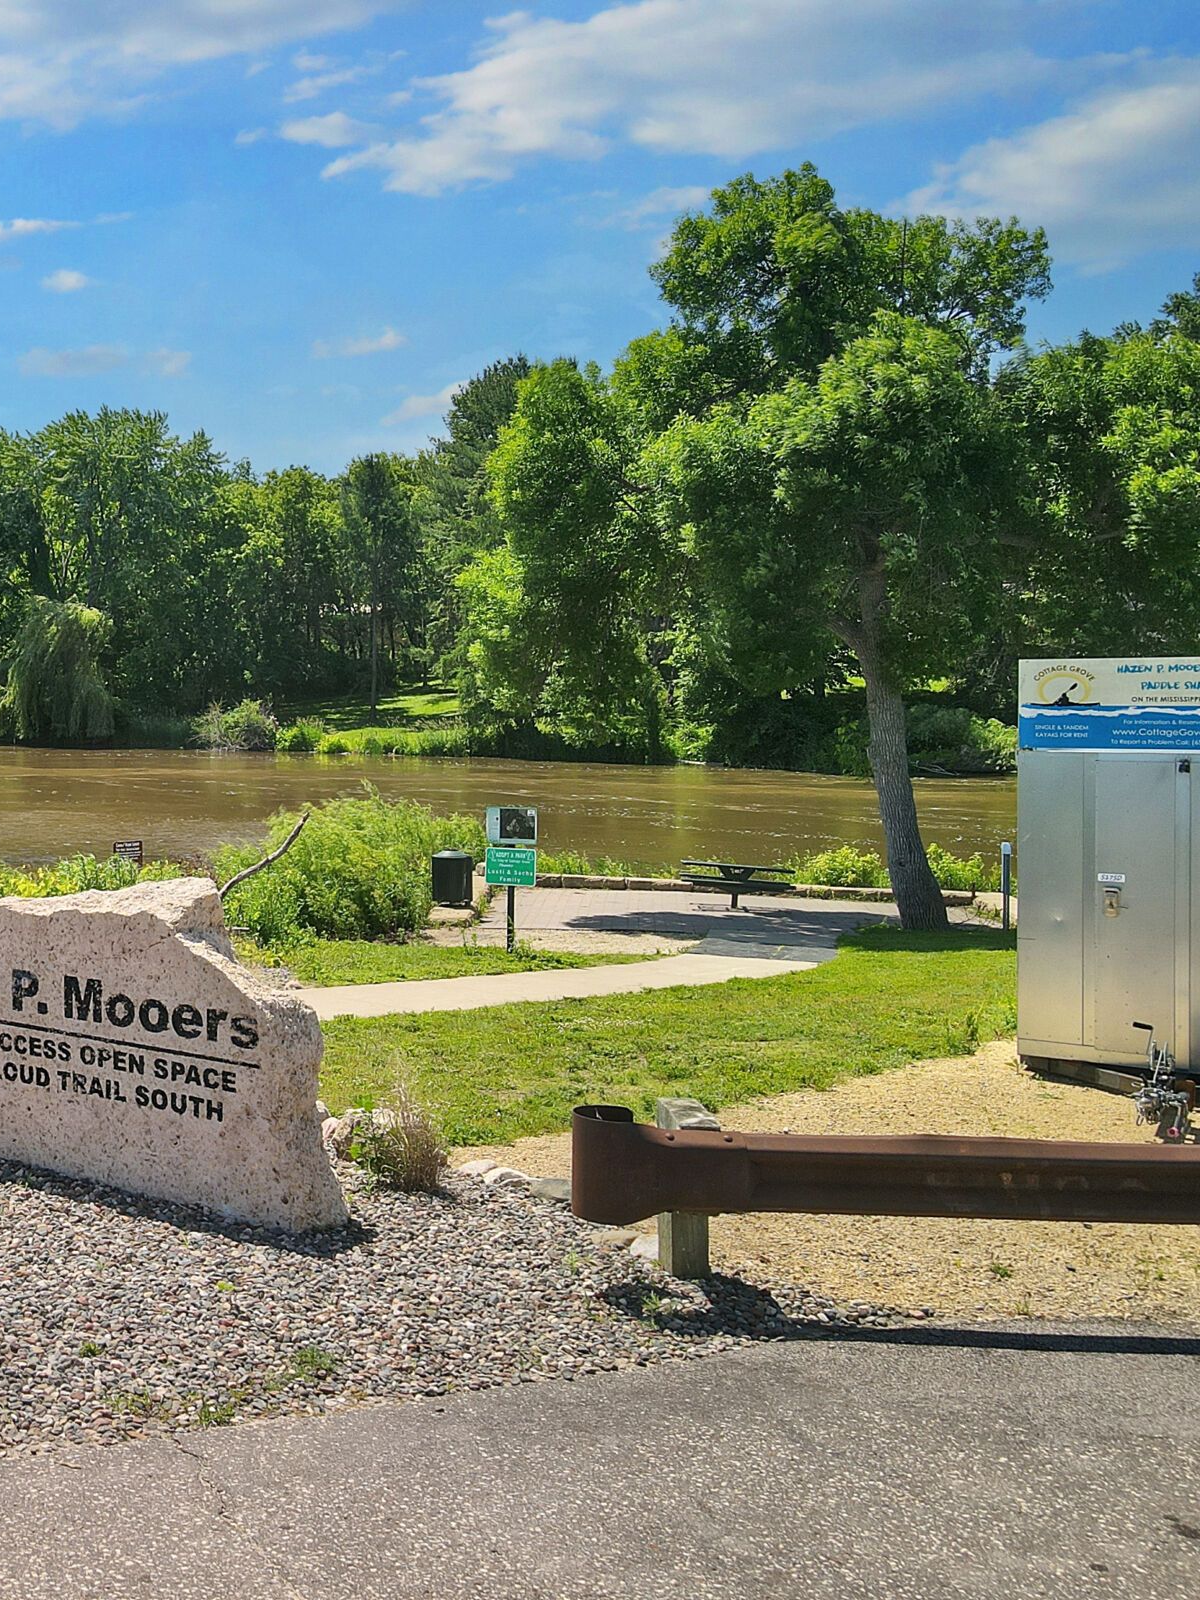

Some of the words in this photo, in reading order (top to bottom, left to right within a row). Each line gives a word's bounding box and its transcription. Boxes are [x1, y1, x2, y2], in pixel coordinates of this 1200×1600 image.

[1033, 665, 1067, 681] COTTAGE
[1069, 666, 1096, 682] GROVE
[1117, 664, 1152, 673] HAZEN
[1157, 664, 1164, 673] P.
[1141, 681, 1180, 690] PADDLE
[12, 968, 48, 1014] P.
[64, 975, 259, 1049] Mooers
[80, 1045, 145, 1075] OPEN
[154, 1058, 237, 1093] SPACE
[57, 1070, 127, 1103] TRAIL
[135, 1085, 224, 1122] SOUTH
